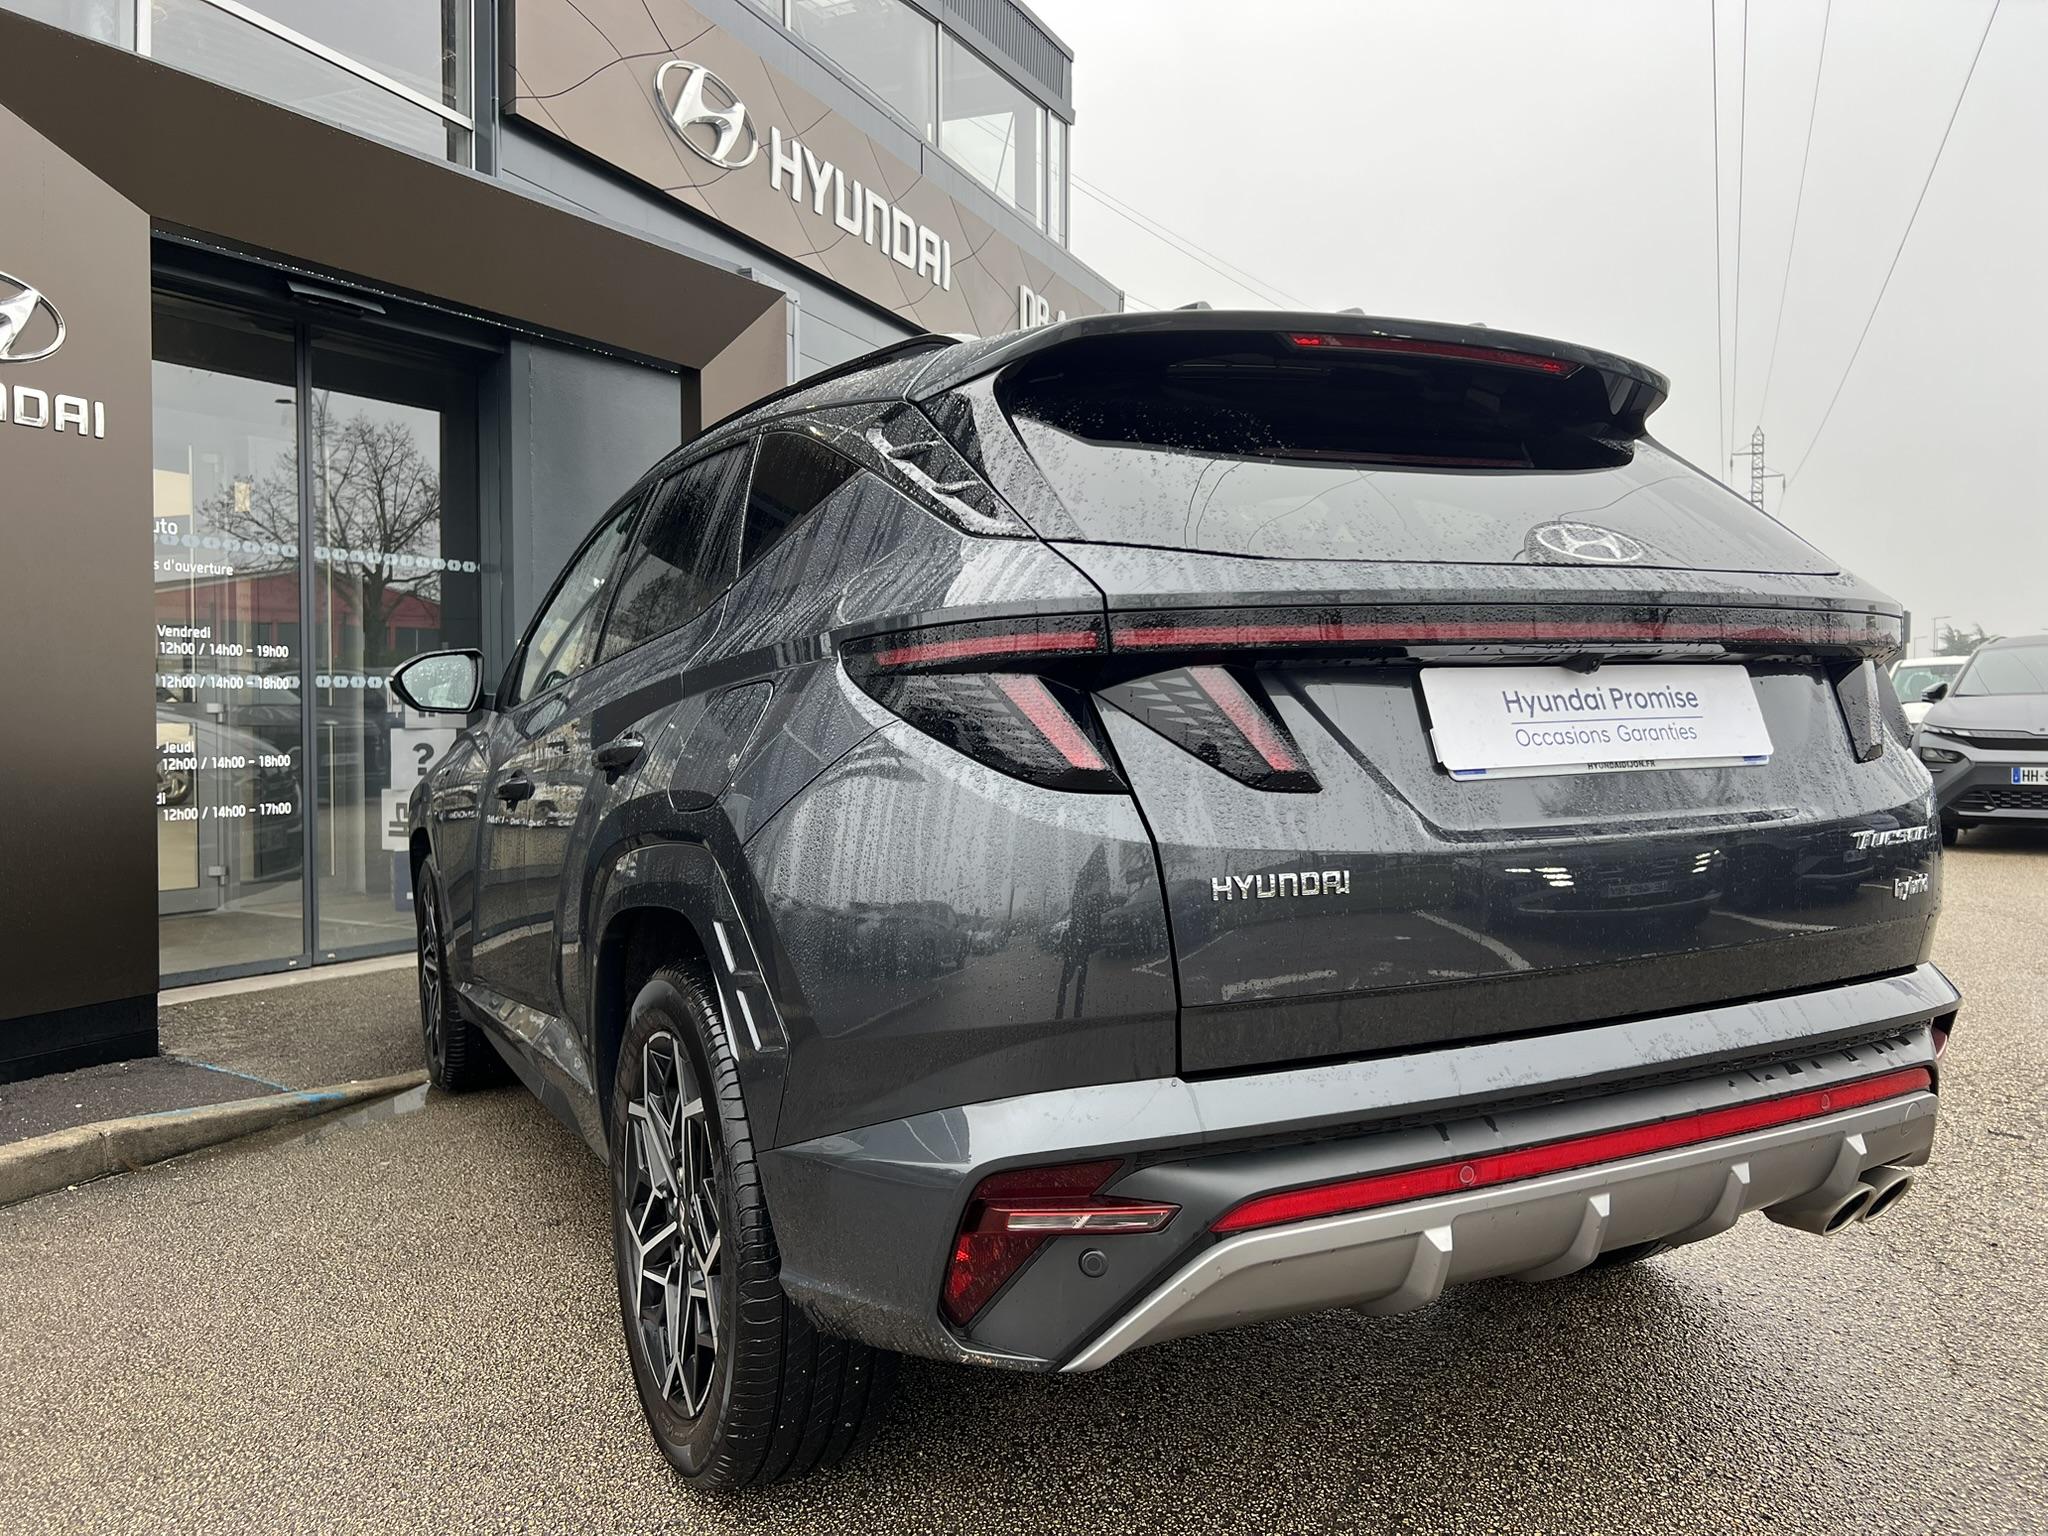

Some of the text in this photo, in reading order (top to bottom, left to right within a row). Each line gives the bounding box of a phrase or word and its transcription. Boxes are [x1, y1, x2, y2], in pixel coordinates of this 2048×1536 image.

[770, 126, 952, 291] HYUNDAI
[0, 382, 105, 440] DAI
[163, 559, 234, 576] d'ouverture
[157, 624, 211, 639] Vendredi
[160, 642, 195, 655] 12h00
[209, 643, 243, 657] 14h00
[256, 645, 289, 658] 19h00
[161, 676, 196, 688] 12h00
[210, 677, 243, 689] 14h00
[257, 677, 289, 690] 18h00
[1502, 685, 1699, 718] Hyundai Promise
[1515, 722, 1698, 748] Occasions Garanties
[162, 741, 195, 754] Jeudi
[162, 758, 198, 771] 12h00
[211, 756, 245, 769] 14h00
[259, 755, 291, 768] 18h00
[163, 808, 199, 821] 12h00
[212, 805, 246, 818] 14h00
[260, 802, 292, 816] 17h00
[1210, 869, 1351, 901] HYUNDAI
